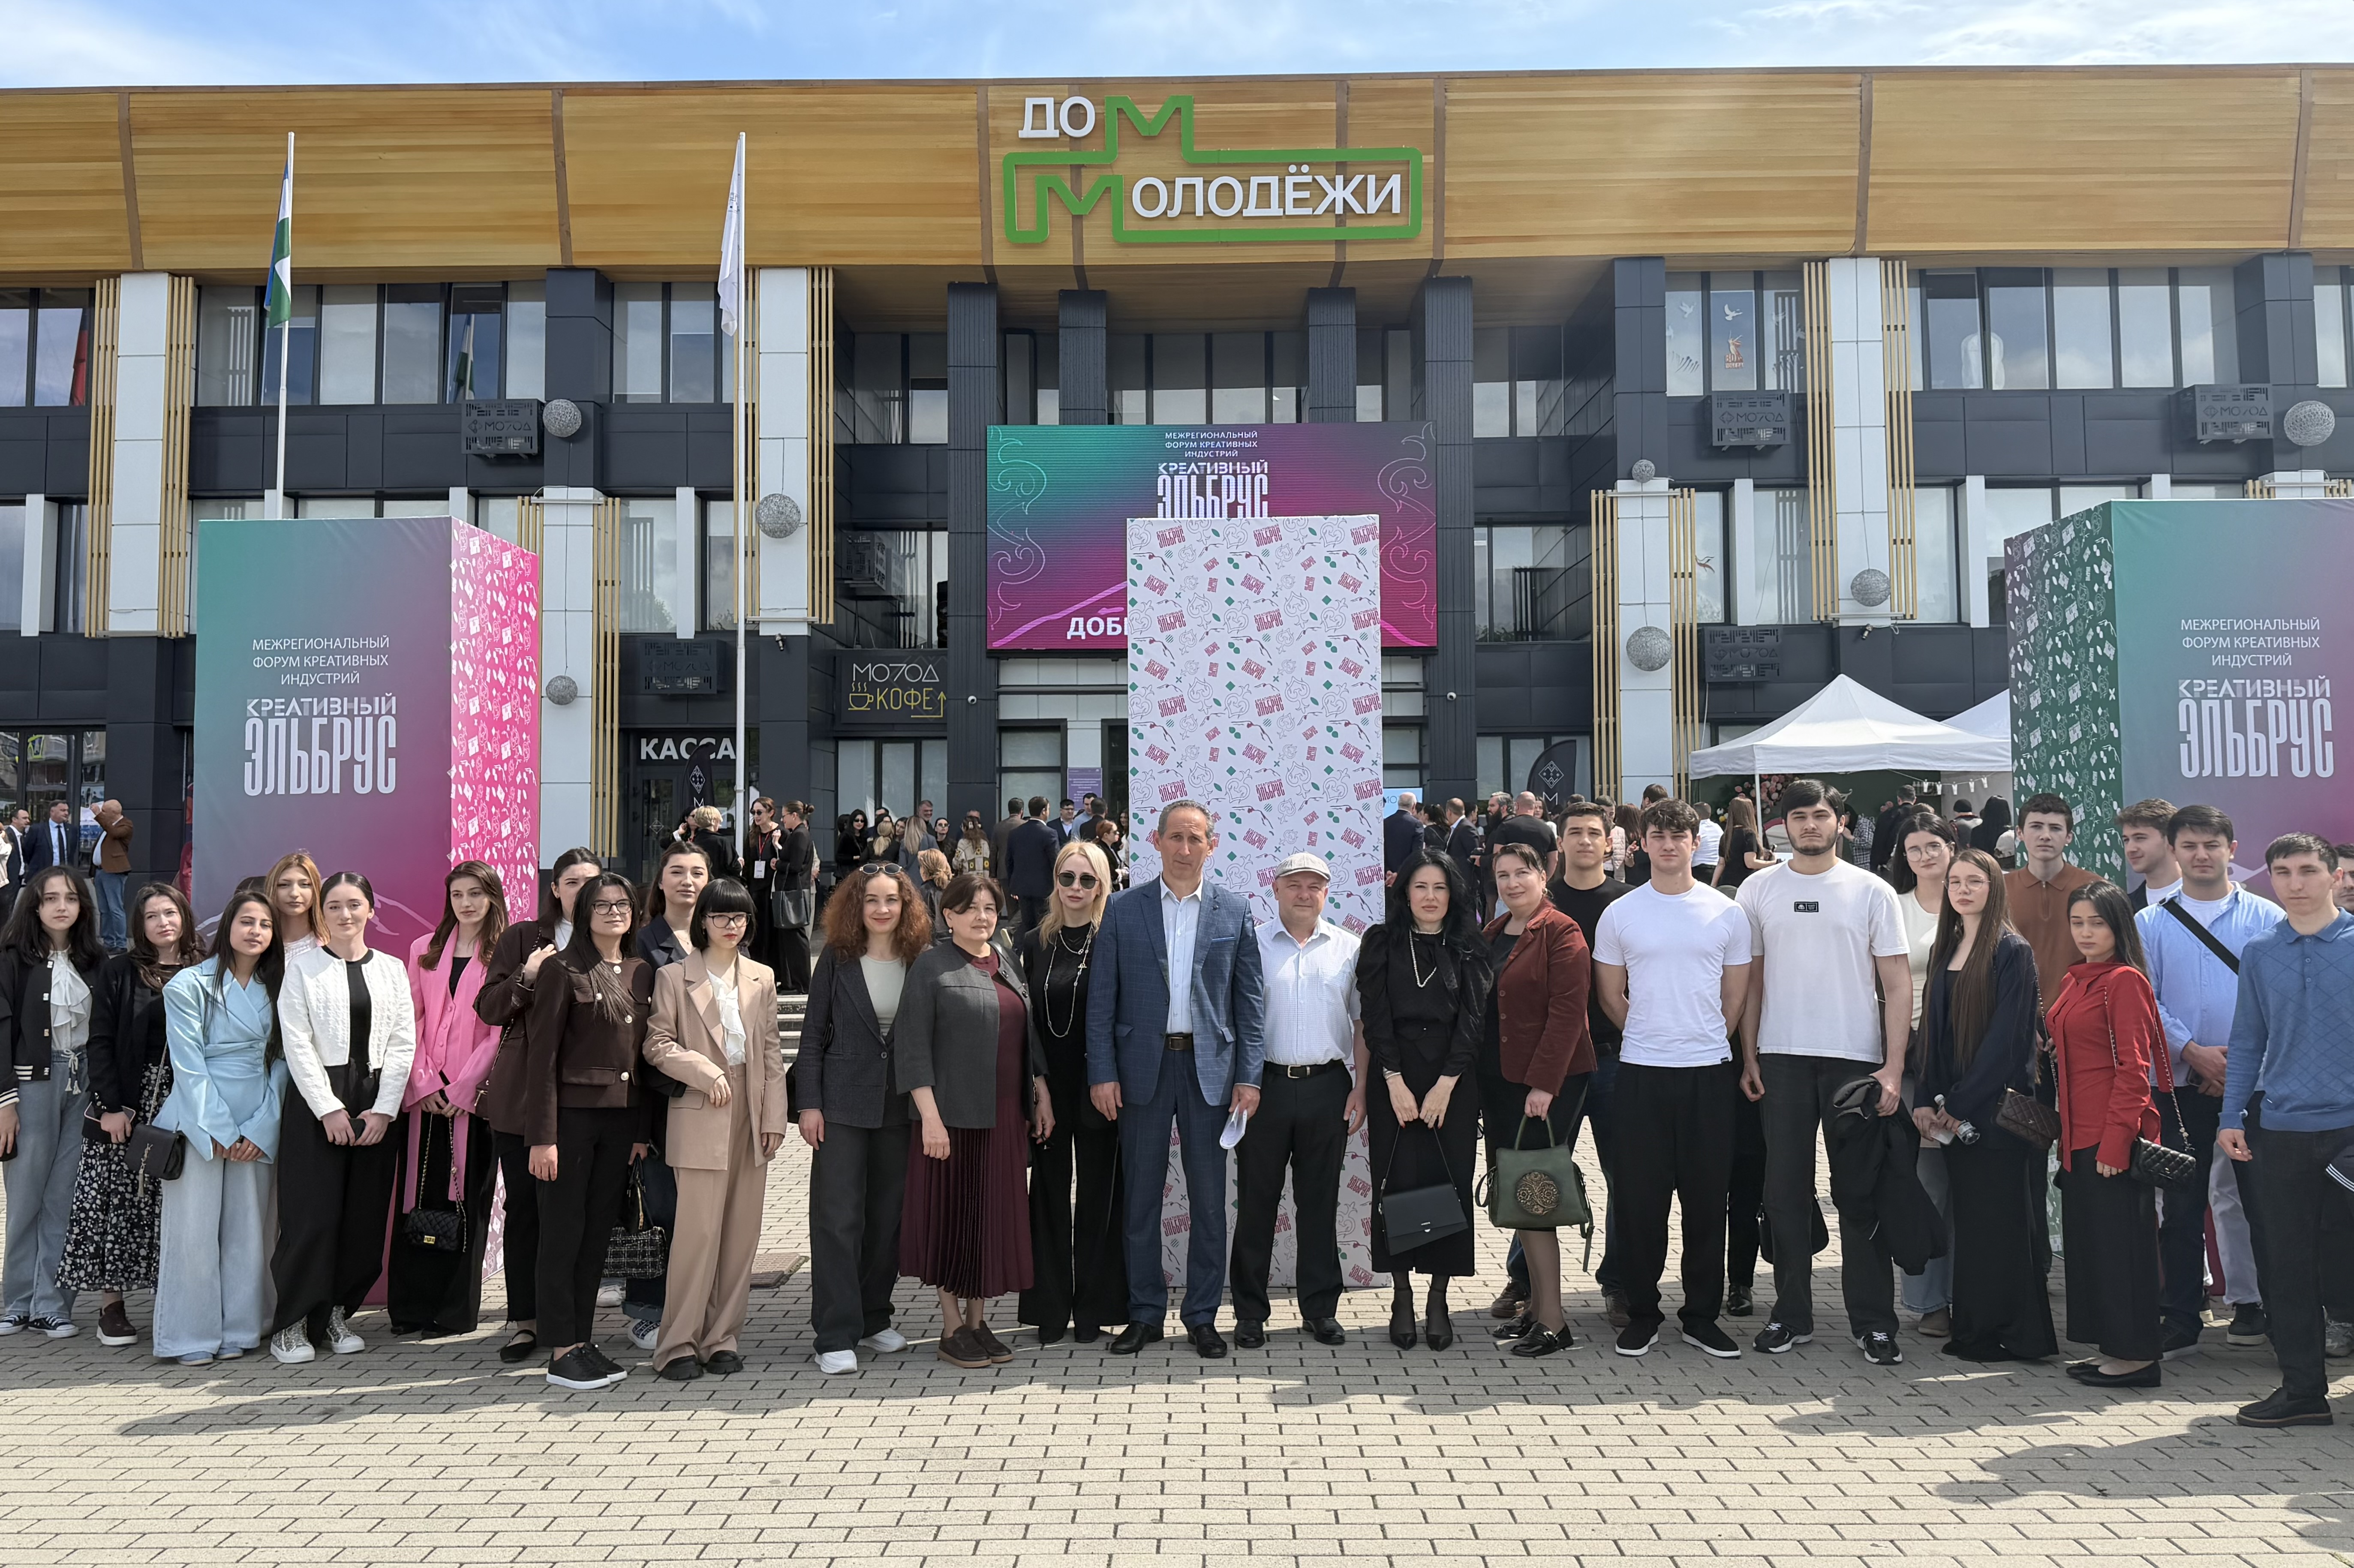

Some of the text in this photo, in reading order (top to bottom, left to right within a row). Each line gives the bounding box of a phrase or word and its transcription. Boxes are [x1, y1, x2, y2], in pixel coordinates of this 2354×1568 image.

[1165, 431, 1258, 439] МЕЖРЕГИОНАЛЬНЫЙ
[1185, 450, 1238, 458] ИНДУСТРИЙ
[1158, 459, 1268, 474] КРЕАТИВНЫЙ
[1157, 474, 1268, 518] ЭЛЬБРУС
[2181, 617, 2320, 631] МЕЖРЕГИОНАЛЬНЫЙ
[252, 635, 389, 651] МЕЖРЕГИОНАЛЬНЫЙ
[2182, 637, 2320, 648] ФОРУМ КРЕАТИВНЫХ
[253, 655, 388, 668] ФОРУМ КРЕАТИВНЫХ
[2212, 653, 2292, 667] ИНДУСТРИЙ
[281, 671, 360, 687] ИНДУСТРИЙ
[2178, 675, 2330, 697] КРЕАТИВНЫЙ
[247, 693, 396, 717] КРЕАТИВНЫЙ
[877, 688, 933, 710] КОФЕ
[2178, 698, 2334, 778] ЭЛЬБРУС
[244, 715, 396, 796] ЭЛЬБРУС
[1257, 868, 1276, 887] ЭЛЬБ
